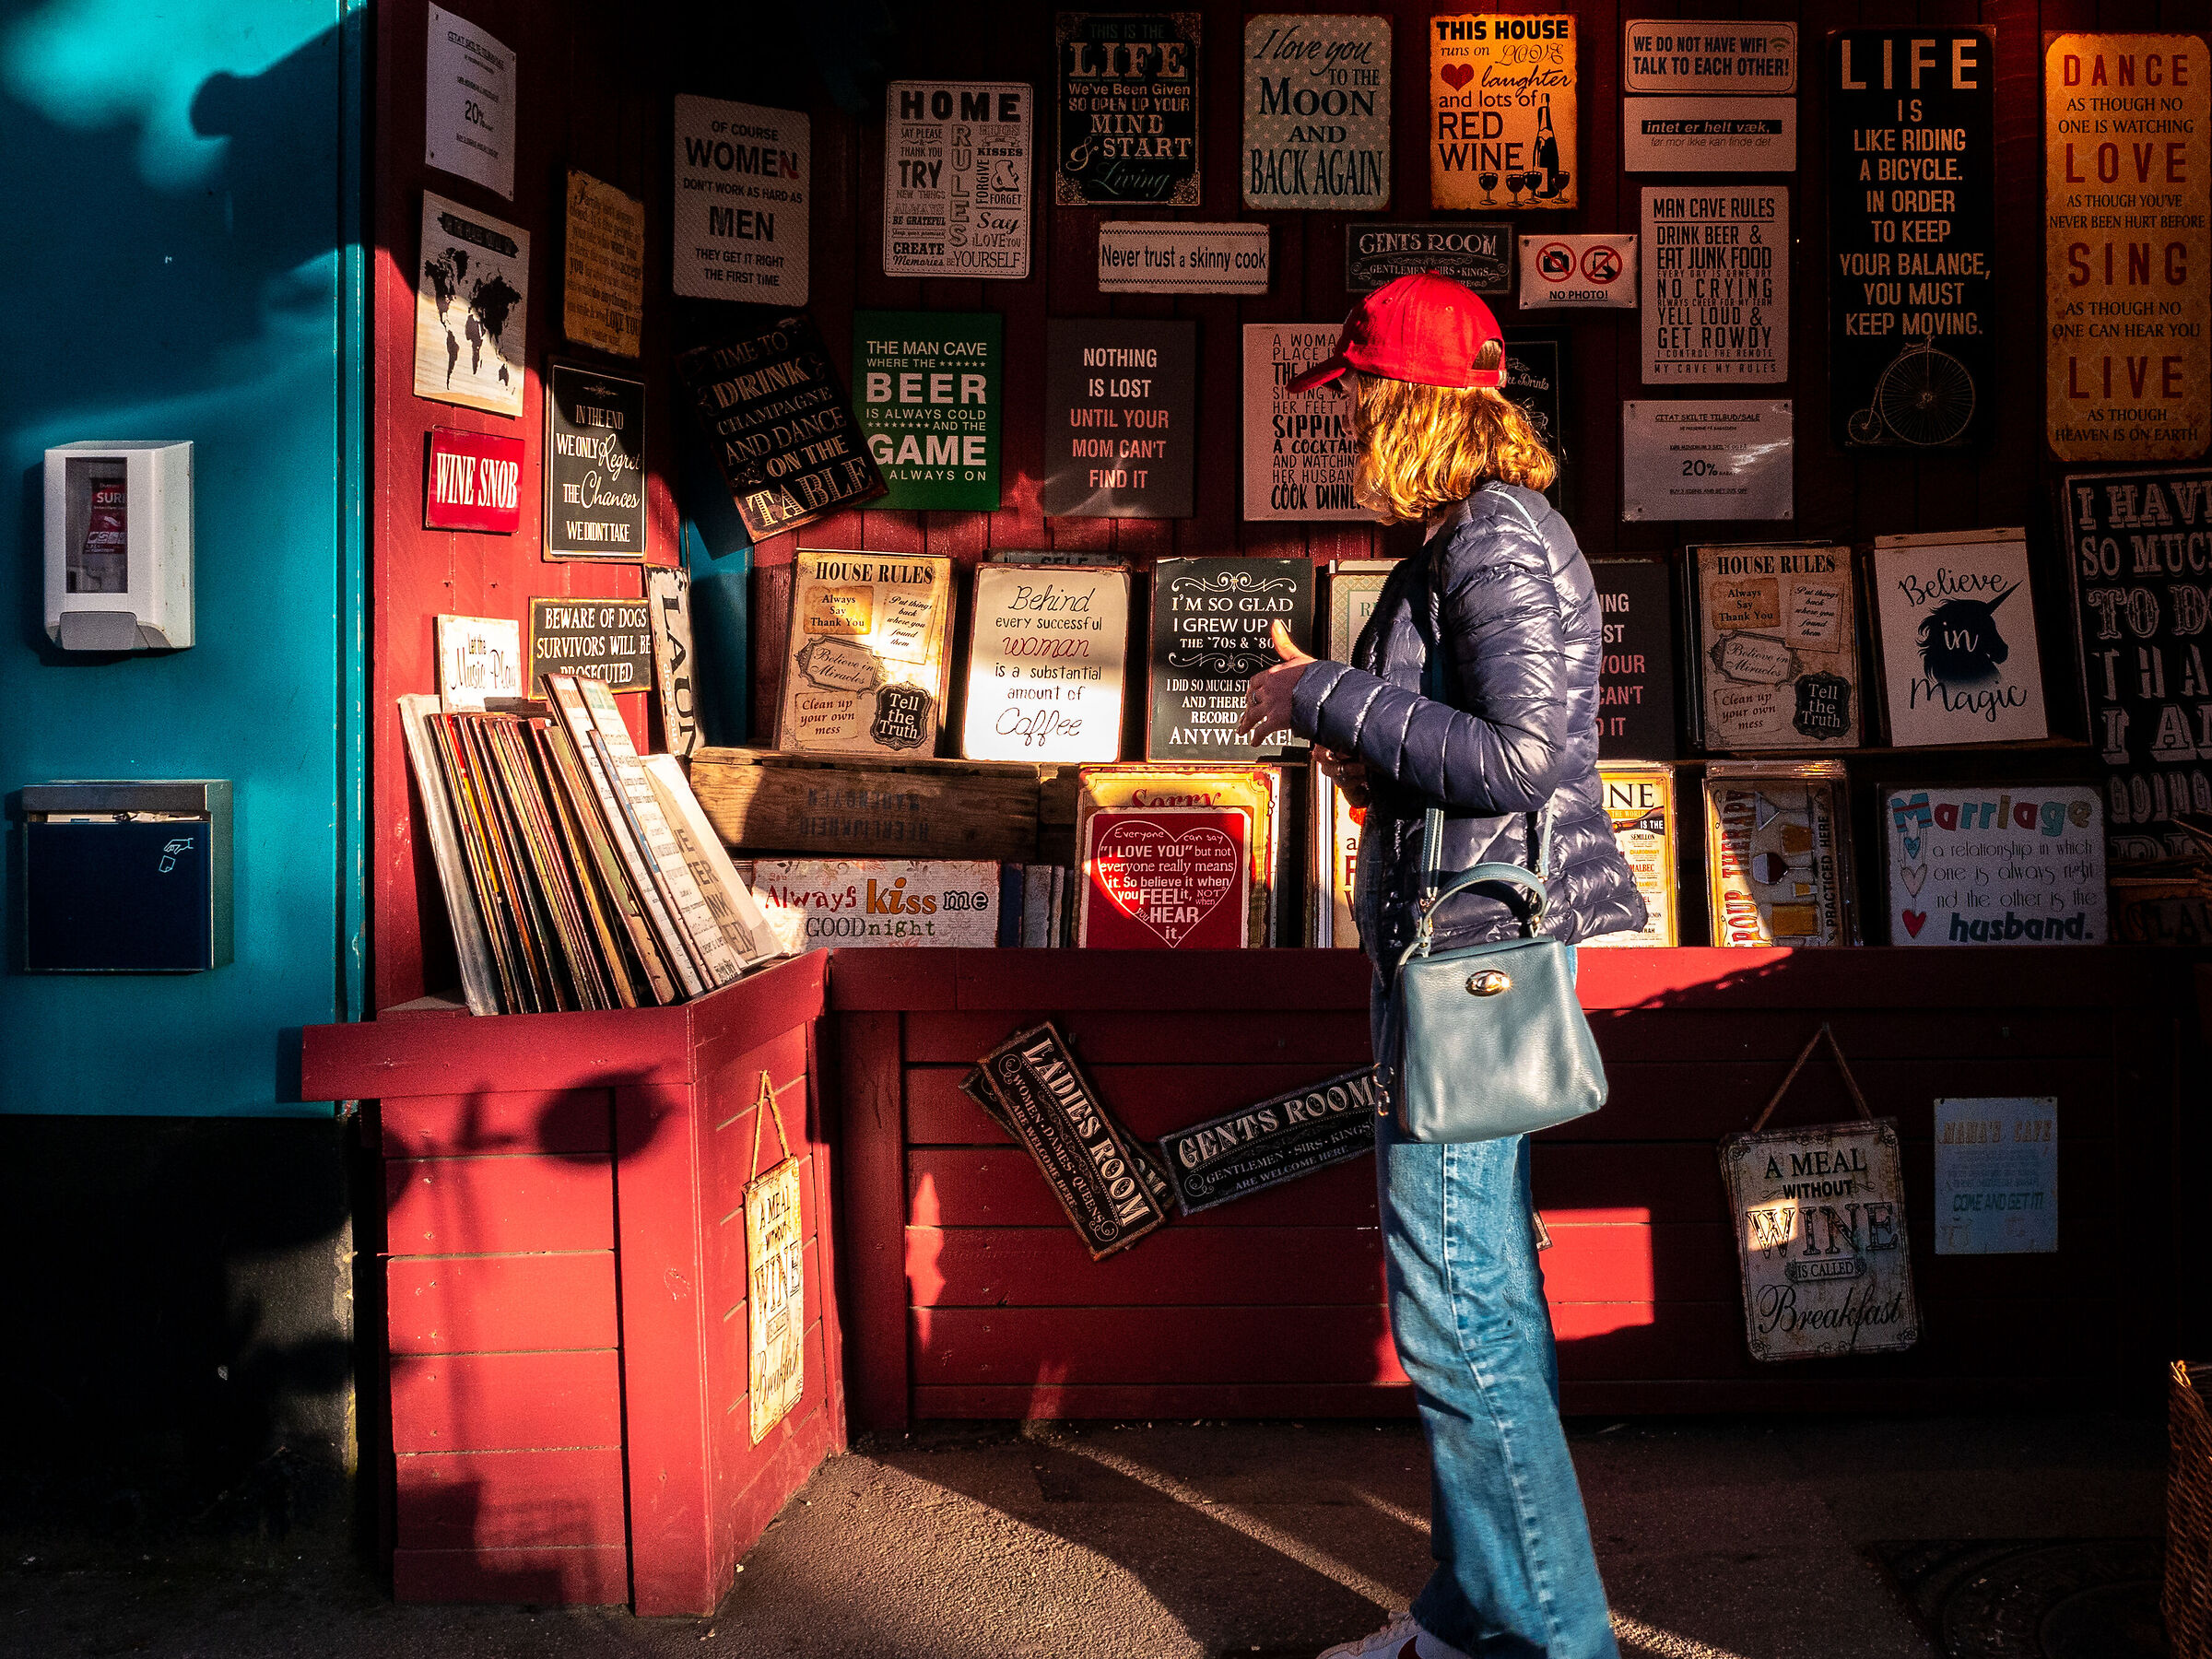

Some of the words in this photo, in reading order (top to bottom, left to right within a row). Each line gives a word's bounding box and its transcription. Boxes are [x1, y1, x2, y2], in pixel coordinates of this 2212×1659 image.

[1437, 20, 1487, 40] THIS
[1495, 20, 1569, 40] HOUSE
[1633, 37, 1652, 51] WE
[1656, 37, 1673, 52] DO
[1677, 37, 1700, 53] NOT
[1704, 37, 1735, 53] HAVE
[1740, 37, 1767, 53] WIFI
[1069, 42, 1188, 81] LIFE
[1633, 57, 1667, 74] TALK
[1672, 57, 1689, 74] TO
[1694, 58, 1733, 75] EACH
[1737, 58, 1790, 76] OTHER!
[1841, 40, 1977, 89] LIFE
[2065, 54, 2189, 86] DANCE
[1069, 83, 1109, 95] We've
[1112, 83, 1147, 95] Been
[1151, 83, 1191, 95] Given
[1328, 69, 1347, 86] TO
[1351, 69, 1380, 86] THE
[1481, 65, 1571, 98] laughter
[900, 90, 1021, 122] HOME
[1259, 76, 1377, 116] MOON
[712, 122, 727, 133] OF
[731, 124, 779, 141] COURSE
[1090, 114, 1165, 135] MIND
[1288, 125, 1347, 143] AND
[1438, 112, 1503, 139] RED
[1646, 122, 1680, 133] intet
[1684, 123, 1700, 133] er
[1704, 122, 1731, 133] helt
[2058, 120, 2089, 134] ONE
[2095, 120, 2108, 134] IS
[2112, 120, 2194, 134] WATCHING
[977, 147, 1023, 158] KISSES
[1853, 129, 1896, 151] LIKE
[1901, 129, 1966, 151] RIDING
[685, 137, 799, 180] WOMEN
[1438, 142, 1524, 171] WINE
[2065, 143, 2187, 183] LOVE
[898, 160, 943, 189] TRY
[1250, 149, 1308, 195] BACK
[1312, 149, 1383, 196] AGAIN
[684, 178, 712, 193] DON'T
[715, 183, 745, 197] WORK
[747, 187, 760, 199] AS
[762, 188, 787, 202] HARD
[790, 192, 803, 205] AS
[990, 194, 1022, 206] FORGET
[1653, 198, 1685, 218] MAN
[1689, 198, 1726, 218] CAVE
[1731, 198, 1775, 218] RULES
[710, 206, 774, 242] MEN
[893, 241, 945, 255] CREATE
[1359, 233, 1421, 254] GENTS
[1428, 233, 1497, 256] ROOM
[1101, 245, 1141, 267] Never
[1145, 246, 1175, 268] trust
[1180, 255, 1185, 267] a
[1190, 247, 1230, 273] skinny
[1235, 248, 1266, 269] cook
[2068, 241, 2187, 286] SING
[1549, 290, 1566, 300] NO
[1568, 290, 1608, 300] PHOTO!
[1657, 278, 1682, 298] NO
[1696, 278, 1772, 298] CRYING
[866, 340, 899, 355] THE
[903, 341, 938, 356] MAN
[943, 342, 987, 357] CAVE
[1083, 348, 1158, 368] NOTHING
[712, 357, 811, 408] DRINK
[866, 372, 987, 404] BEER
[716, 385, 834, 435] CHAMPAGNE
[1273, 401, 1297, 414] HER
[1305, 401, 1335, 414] FEET
[1655, 414, 1679, 422] CITAT
[1682, 414, 1708, 422] SKILTE
[2055, 428, 2110, 441] HEAVEN
[2113, 429, 2124, 441] IS
[2129, 428, 2150, 441] ON
[2155, 428, 2198, 441] EARTH
[556, 433, 576, 457] WE
[576, 436, 600, 459] ONLY
[598, 433, 641, 482] Regret
[867, 434, 987, 466] GAME
[1072, 438, 1113, 458] MOM
[1119, 439, 1167, 459] CAN'T
[436, 453, 476, 505] WINE
[477, 457, 519, 509] SNOB
[889, 470, 955, 481] ALWAYS
[964, 471, 986, 482] ON
[1683, 459, 1718, 477] 20%
[563, 484, 582, 503] THE
[581, 470, 641, 509] Chances
[746, 456, 874, 526] TABLE
[1271, 484, 1308, 511] COOK
[1315, 485, 1365, 511] DINNE
[815, 560, 873, 582] HOUSE
[877, 563, 934, 585] RULES
[1716, 555, 1775, 575] HOUSE
[1781, 554, 1836, 573] RULES
[1008, 583, 1096, 612] Behind
[1898, 568, 2008, 607] Believe
[1171, 594, 1203, 612] I'M
[1208, 597, 1233, 612] SO
[1239, 597, 1294, 612] GLAD
[545, 607, 595, 629] BEWARE
[599, 607, 615, 629] OF
[618, 607, 647, 629] DOGS
[995, 617, 1031, 629] every
[1036, 617, 1102, 630] successful
[1002, 636, 1089, 658] woman
[1943, 621, 1979, 652] in
[889, 692, 919, 711] Tell
[1911, 677, 2027, 723] Magic
[879, 719, 919, 740] Truth
[995, 706, 1083, 747] Coffee
[1890, 793, 2093, 837] Marriage
[1722, 789, 1756, 878] THERAPY
[1818, 816, 1831, 848] HERE
[1630, 864, 1654, 873] MALBEC
[765, 885, 857, 913] Always
[866, 877, 937, 915] kiss
[943, 889, 989, 912] me
[1139, 888, 1184, 905] FEEL
[1821, 854, 1838, 927] PRACTICED
[1149, 906, 1198, 923] HEAR
[1949, 911, 2093, 942] husband.
[1021, 1037, 1102, 1139] LADIES
[1088, 1137, 1151, 1228] ROOM
[1179, 1108, 1280, 1170] GENTS
[1284, 1076, 1376, 1124] ROOM
[1764, 1153, 1783, 1180] A
[1789, 1147, 1867, 1177] MEAL
[1783, 1180, 1853, 1199] WITHOUT
[1745, 1201, 1899, 1260] WINE
[1797, 1265, 1807, 1278] IS
[1810, 1261, 1854, 1277] CALLED
[1756, 1282, 1905, 1345] Breakfast
